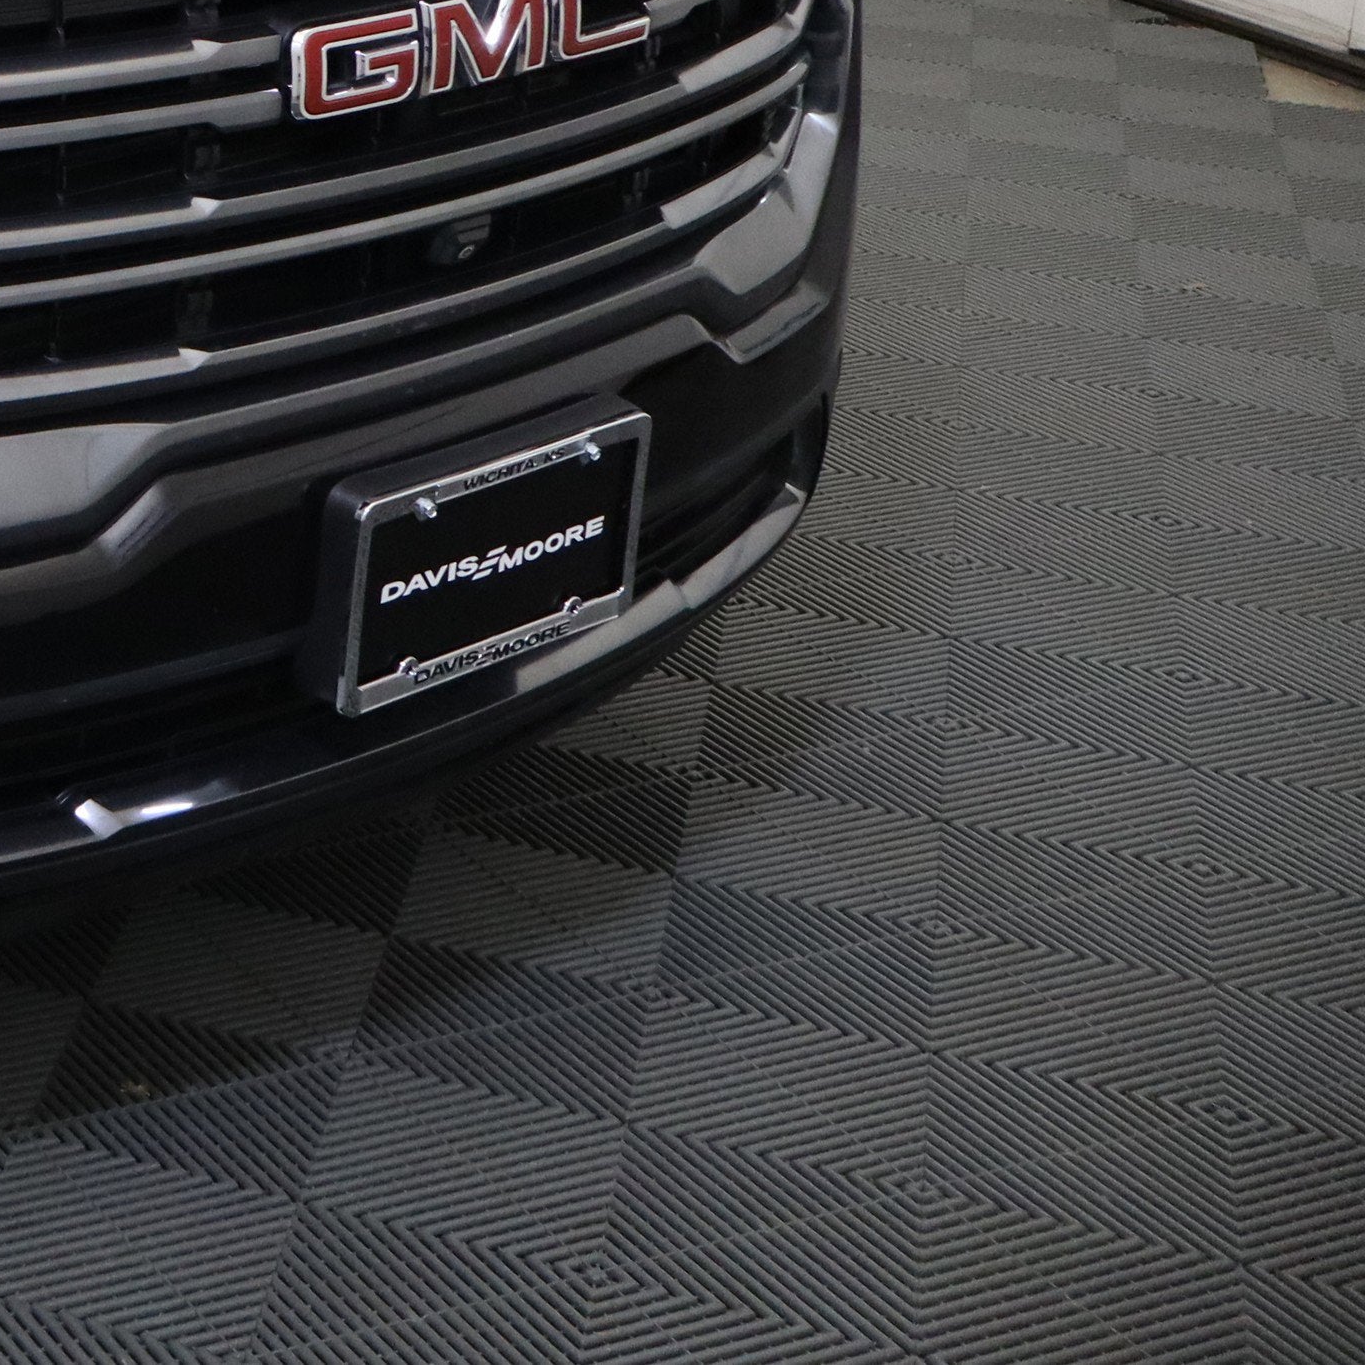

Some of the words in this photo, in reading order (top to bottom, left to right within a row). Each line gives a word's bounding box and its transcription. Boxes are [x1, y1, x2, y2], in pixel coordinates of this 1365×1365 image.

[380, 555, 479, 605] DAVIS
[497, 515, 606, 574] MOORE
[414, 650, 480, 685] DAVIS
[491, 621, 571, 661] MOORE
